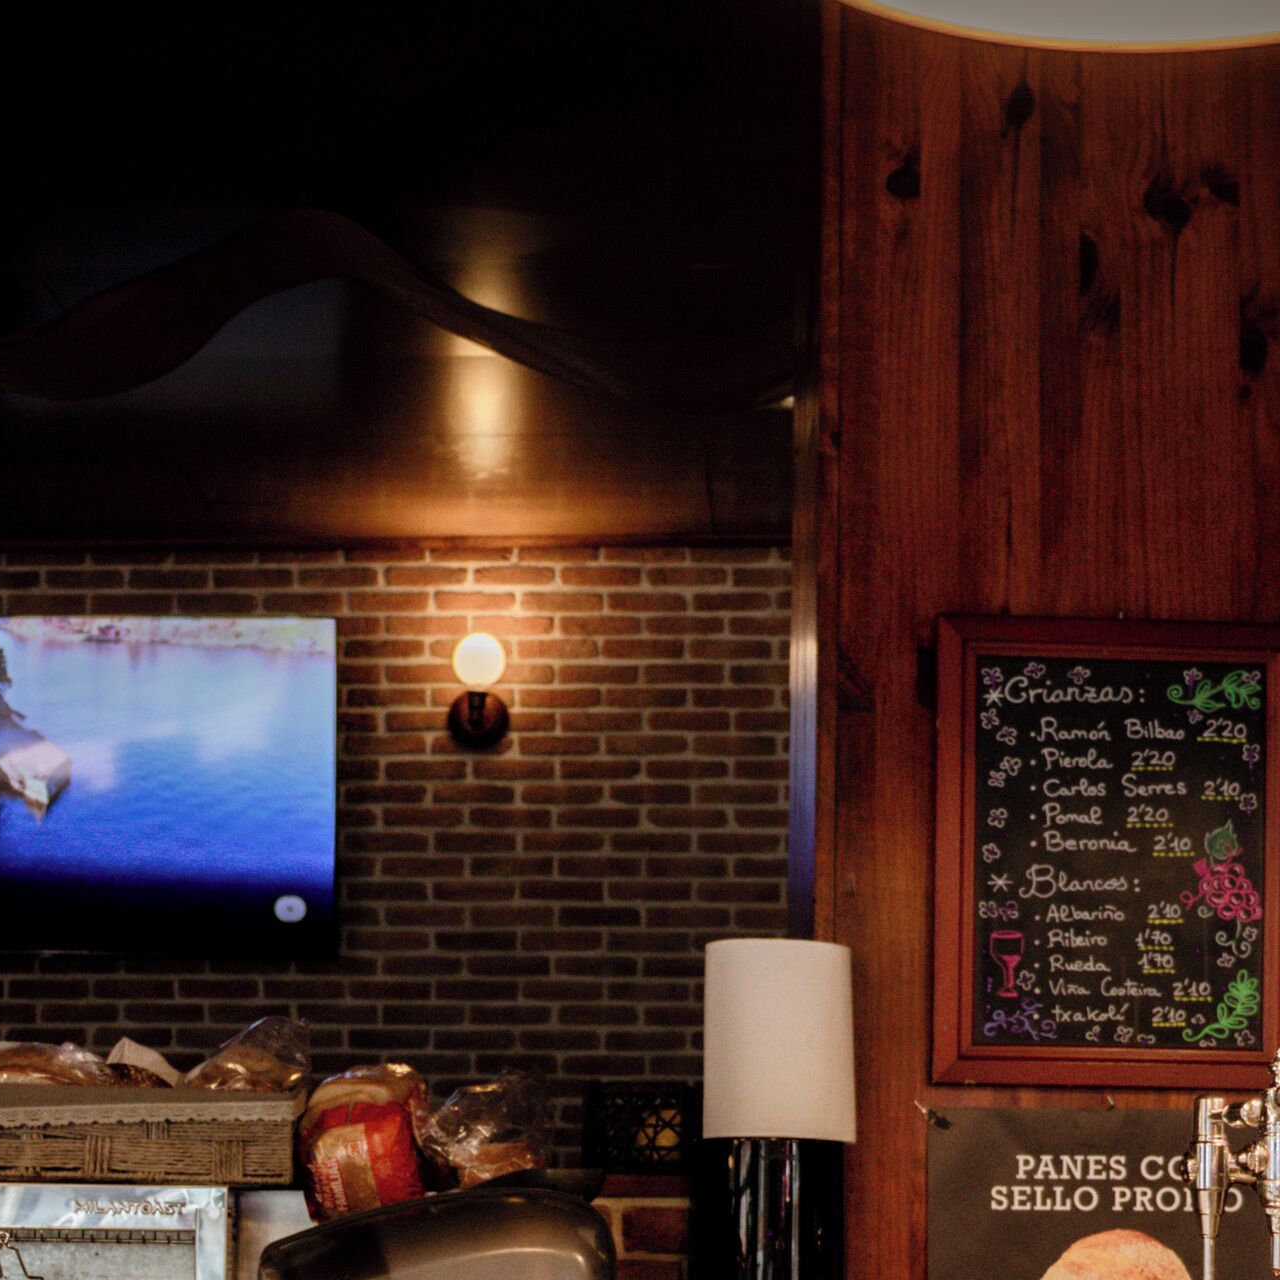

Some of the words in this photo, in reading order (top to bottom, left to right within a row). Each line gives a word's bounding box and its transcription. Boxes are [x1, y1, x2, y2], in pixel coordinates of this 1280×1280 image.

[1004, 675, 1146, 705] Crianzas:
[1037, 716, 1112, 743] Ramón
[1123, 718, 1186, 741] Bilbao
[1041, 748, 1114, 771] Pierola
[1043, 777, 1107, 798] Carlos
[1121, 773, 1187, 798] Serres
[1042, 802, 1104, 828] Pomal
[1043, 830, 1138, 853] Beronia
[1019, 863, 1141, 899] Blancos:
[1046, 904, 1126, 923] Albariño
[1047, 929, 1109, 950] Ribeiro
[1049, 954, 1111, 974] Rueda
[1048, 977, 1091, 997] Viña
[1015, 1155, 1128, 1181] PANES
[990, 1186, 1099, 1212] SELLO
